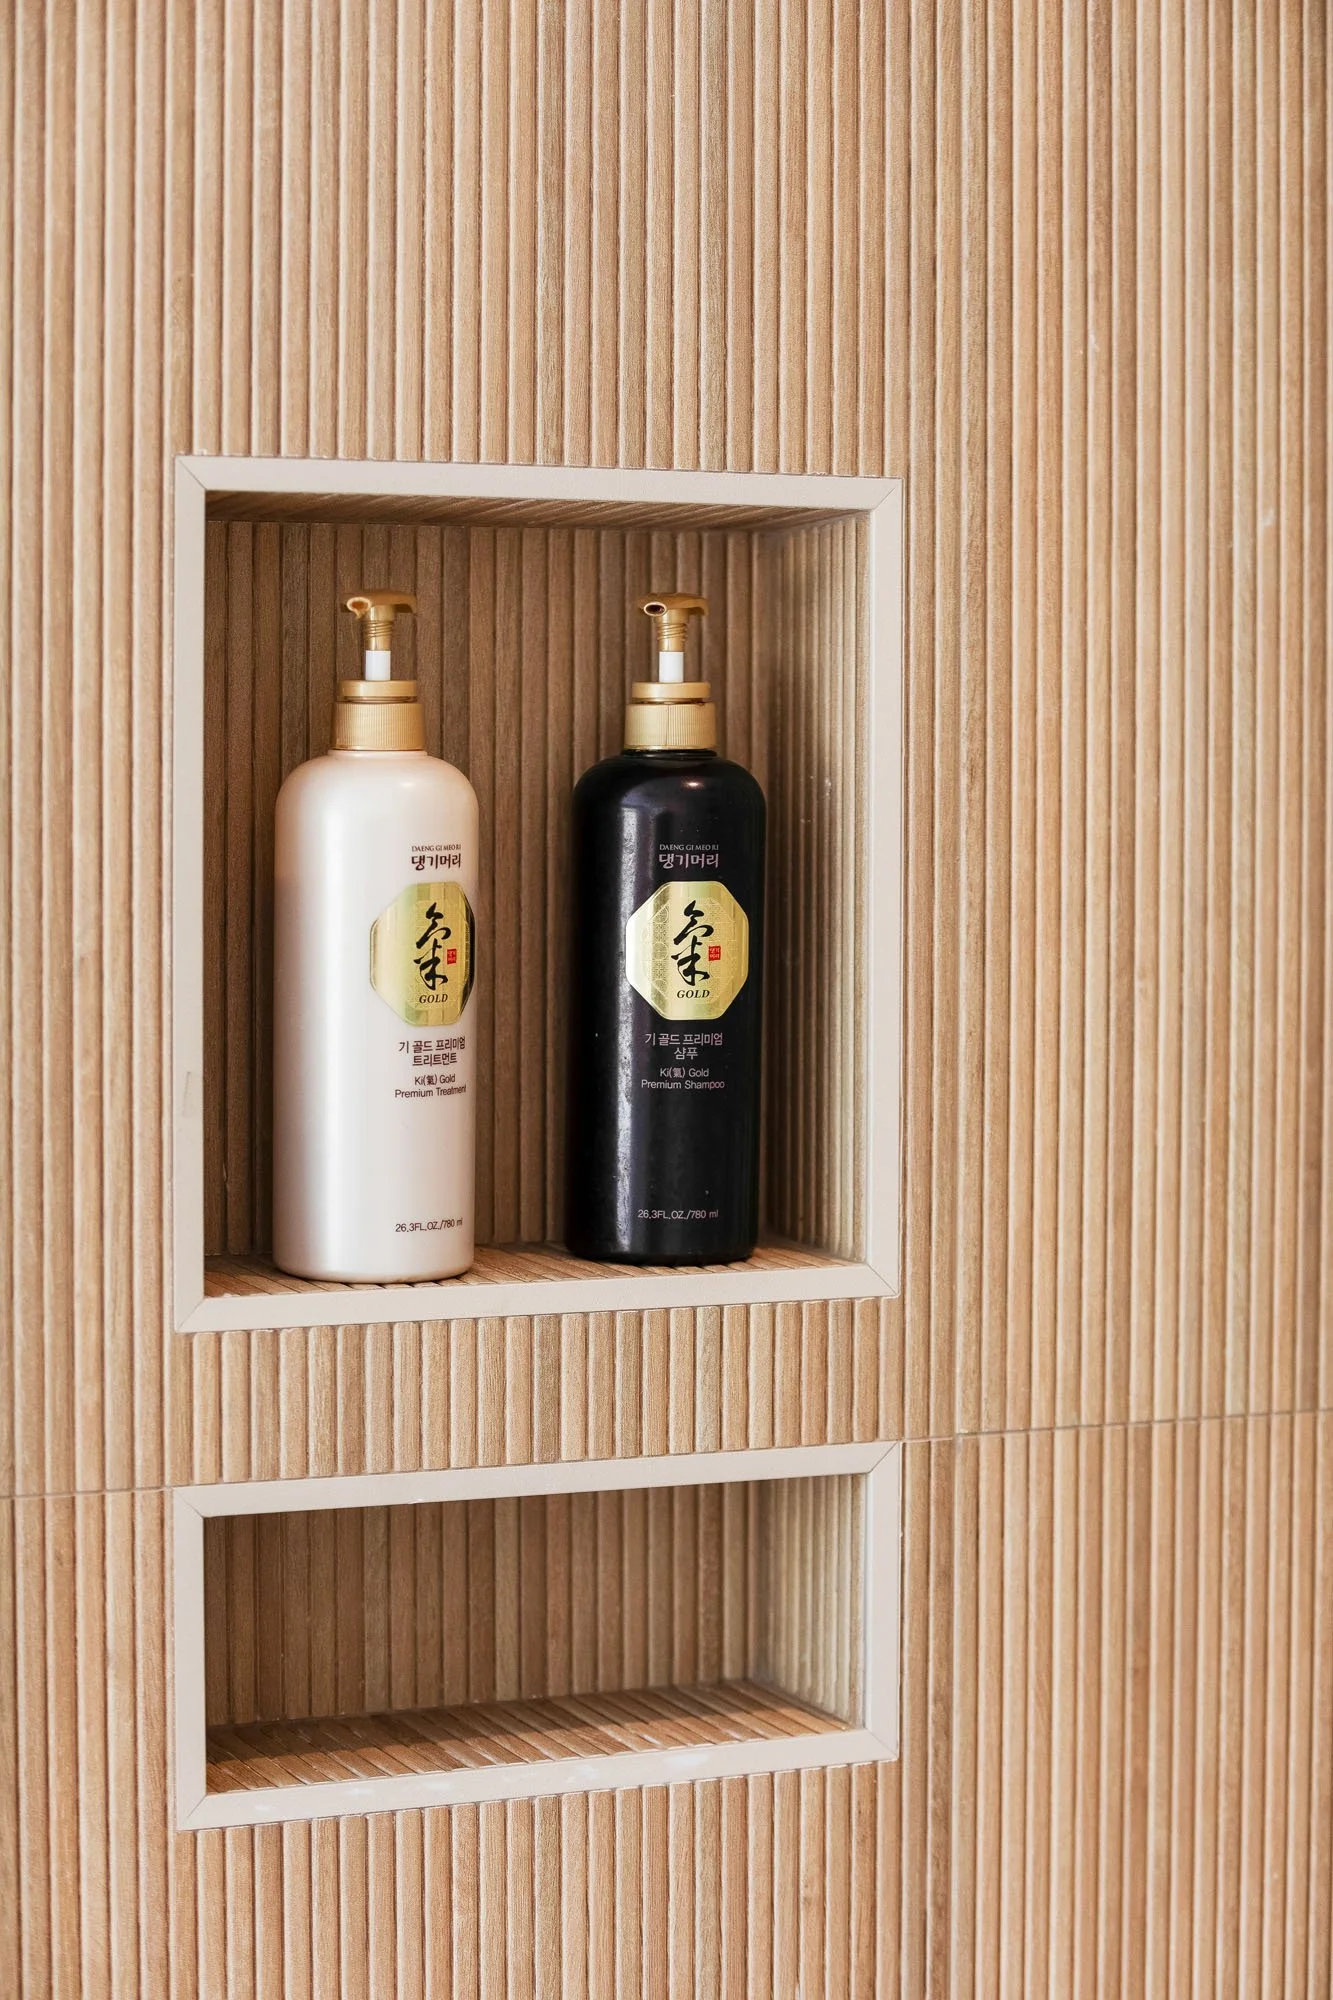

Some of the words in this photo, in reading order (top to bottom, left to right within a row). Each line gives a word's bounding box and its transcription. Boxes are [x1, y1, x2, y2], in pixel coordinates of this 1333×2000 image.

[411, 852, 462, 871] 댕기머리
[658, 853, 720, 870] 댕기머리
[419, 993, 449, 1004] GOLD
[676, 989, 710, 999] GOLD
[399, 1041, 410, 1054] 기
[412, 1040, 433, 1054] 골드
[435, 1036, 466, 1052] 프리미엄
[644, 1033, 656, 1046] 기
[658, 1033, 681, 1046] 골드
[682, 1032, 723, 1046] 프리미엄
[412, 1052, 458, 1067] 트리트먼트
[674, 1047, 699, 1060] 샴푸
[439, 1073, 456, 1084] Gold
[688, 1067, 710, 1078] Gold
[394, 1089, 434, 1099] Premium
[436, 1084, 467, 1096] Treatment
[641, 1079, 682, 1090] Premium
[684, 1079, 725, 1091] Shampoo
[708, 1209, 719, 1219] ml
